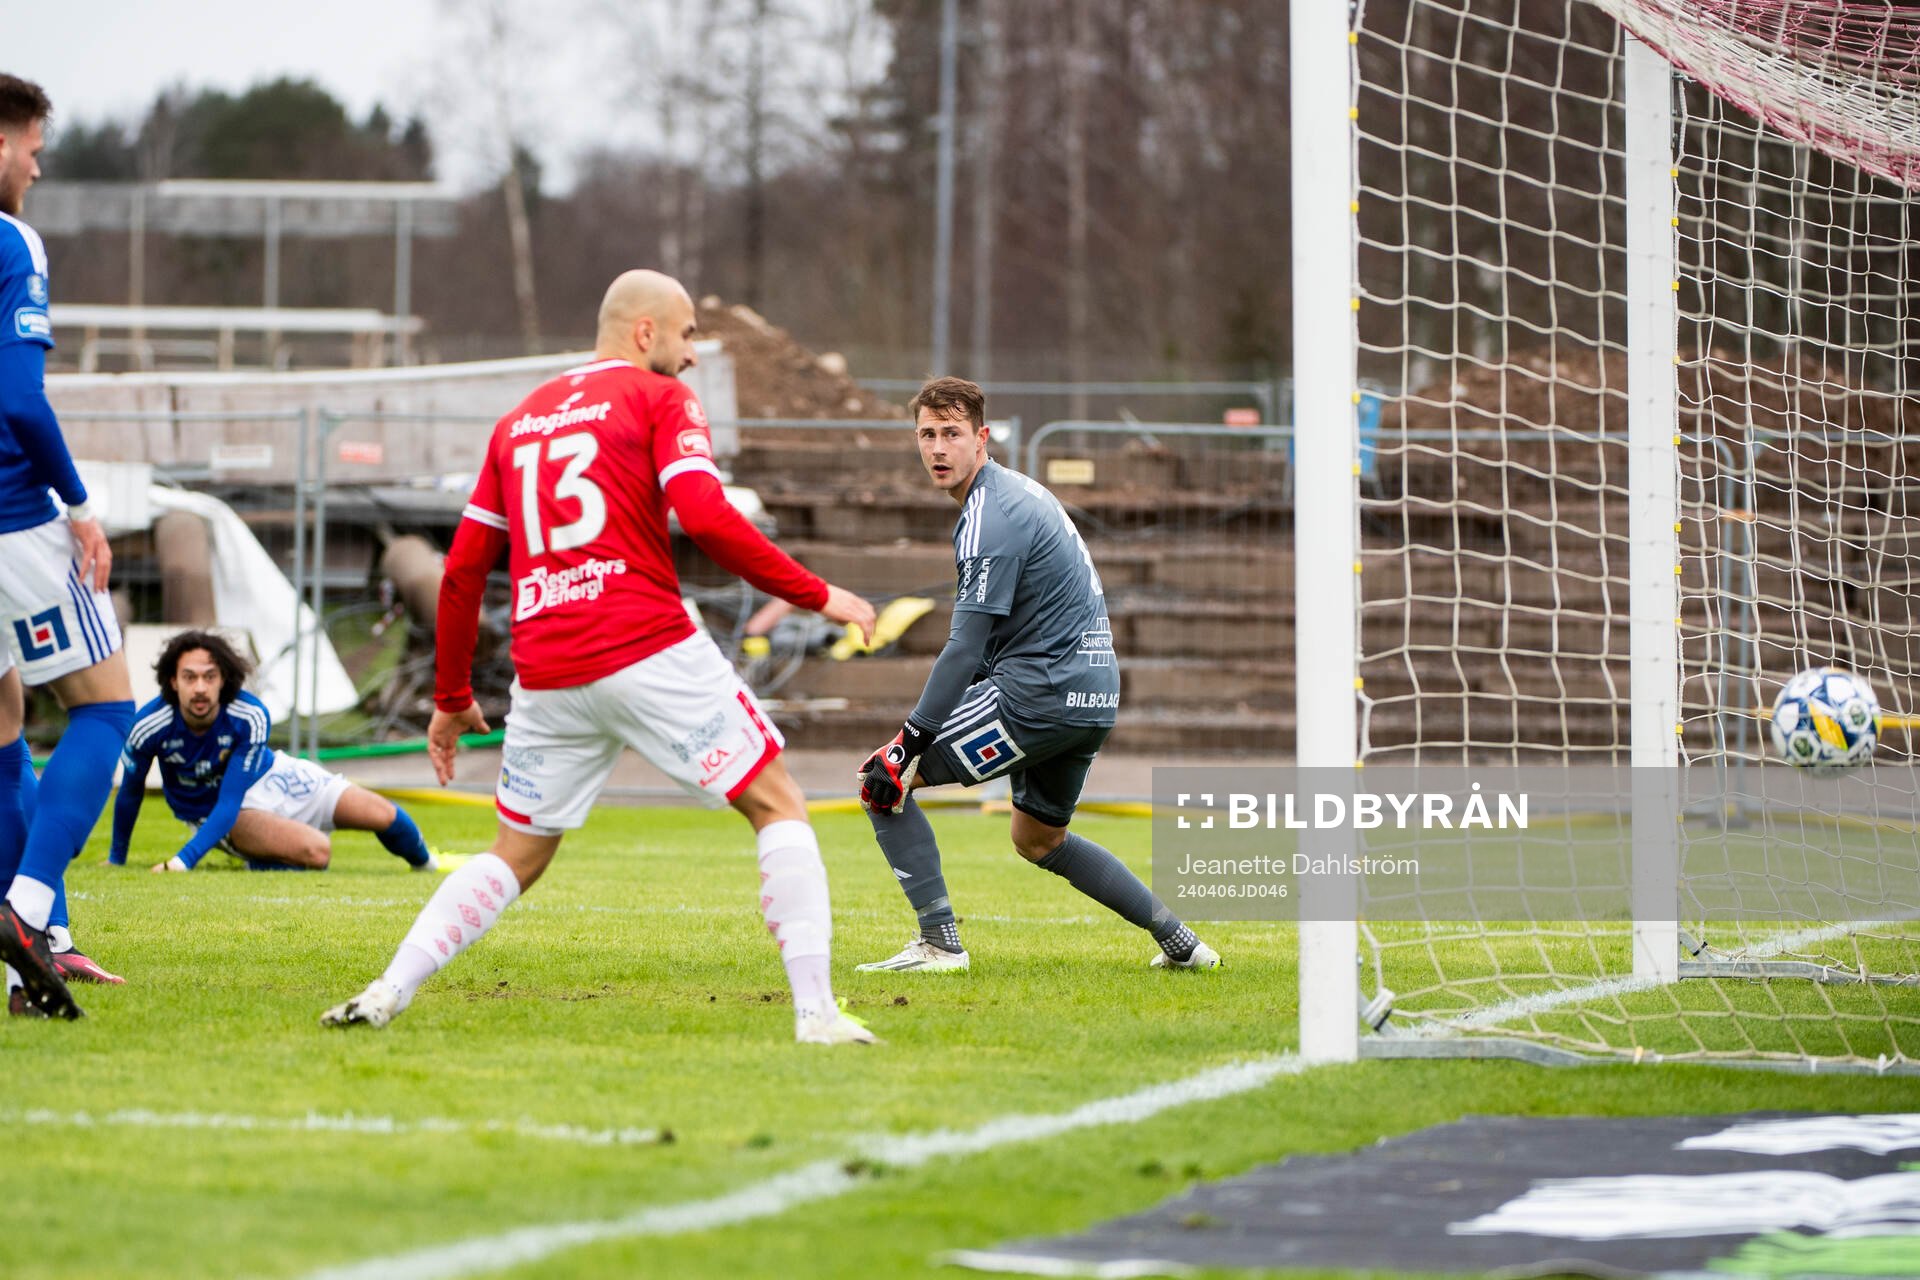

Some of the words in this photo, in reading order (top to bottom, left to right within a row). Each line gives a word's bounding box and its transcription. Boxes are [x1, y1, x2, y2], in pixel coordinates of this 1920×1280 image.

[510, 401, 612, 439] skogsmat
[513, 431, 607, 558] 13
[976, 558, 992, 604] stadium
[700, 748, 730, 774] ICA
